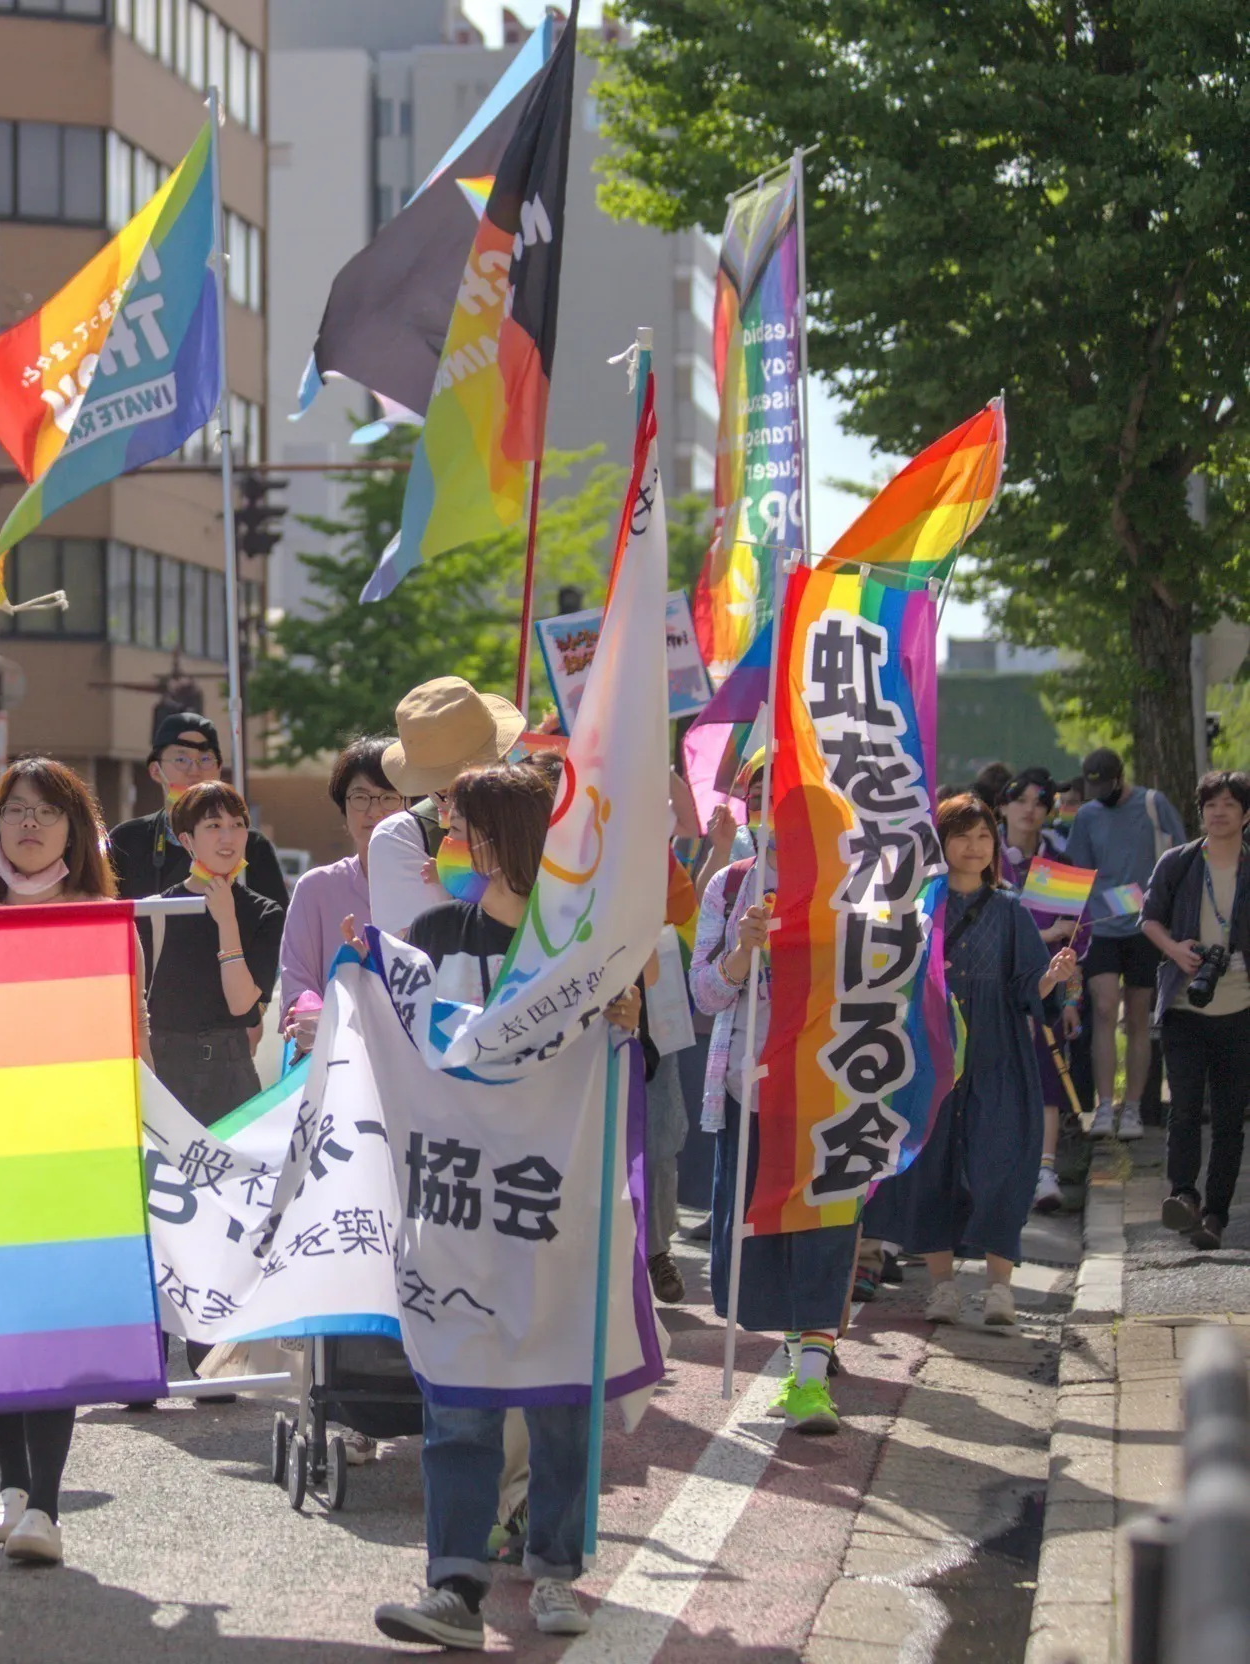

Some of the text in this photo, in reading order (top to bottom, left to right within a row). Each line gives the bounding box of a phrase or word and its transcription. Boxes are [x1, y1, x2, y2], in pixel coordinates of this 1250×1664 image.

[810, 618, 942, 1198] 虹をかける会
[404, 1130, 563, 1243] 協会
